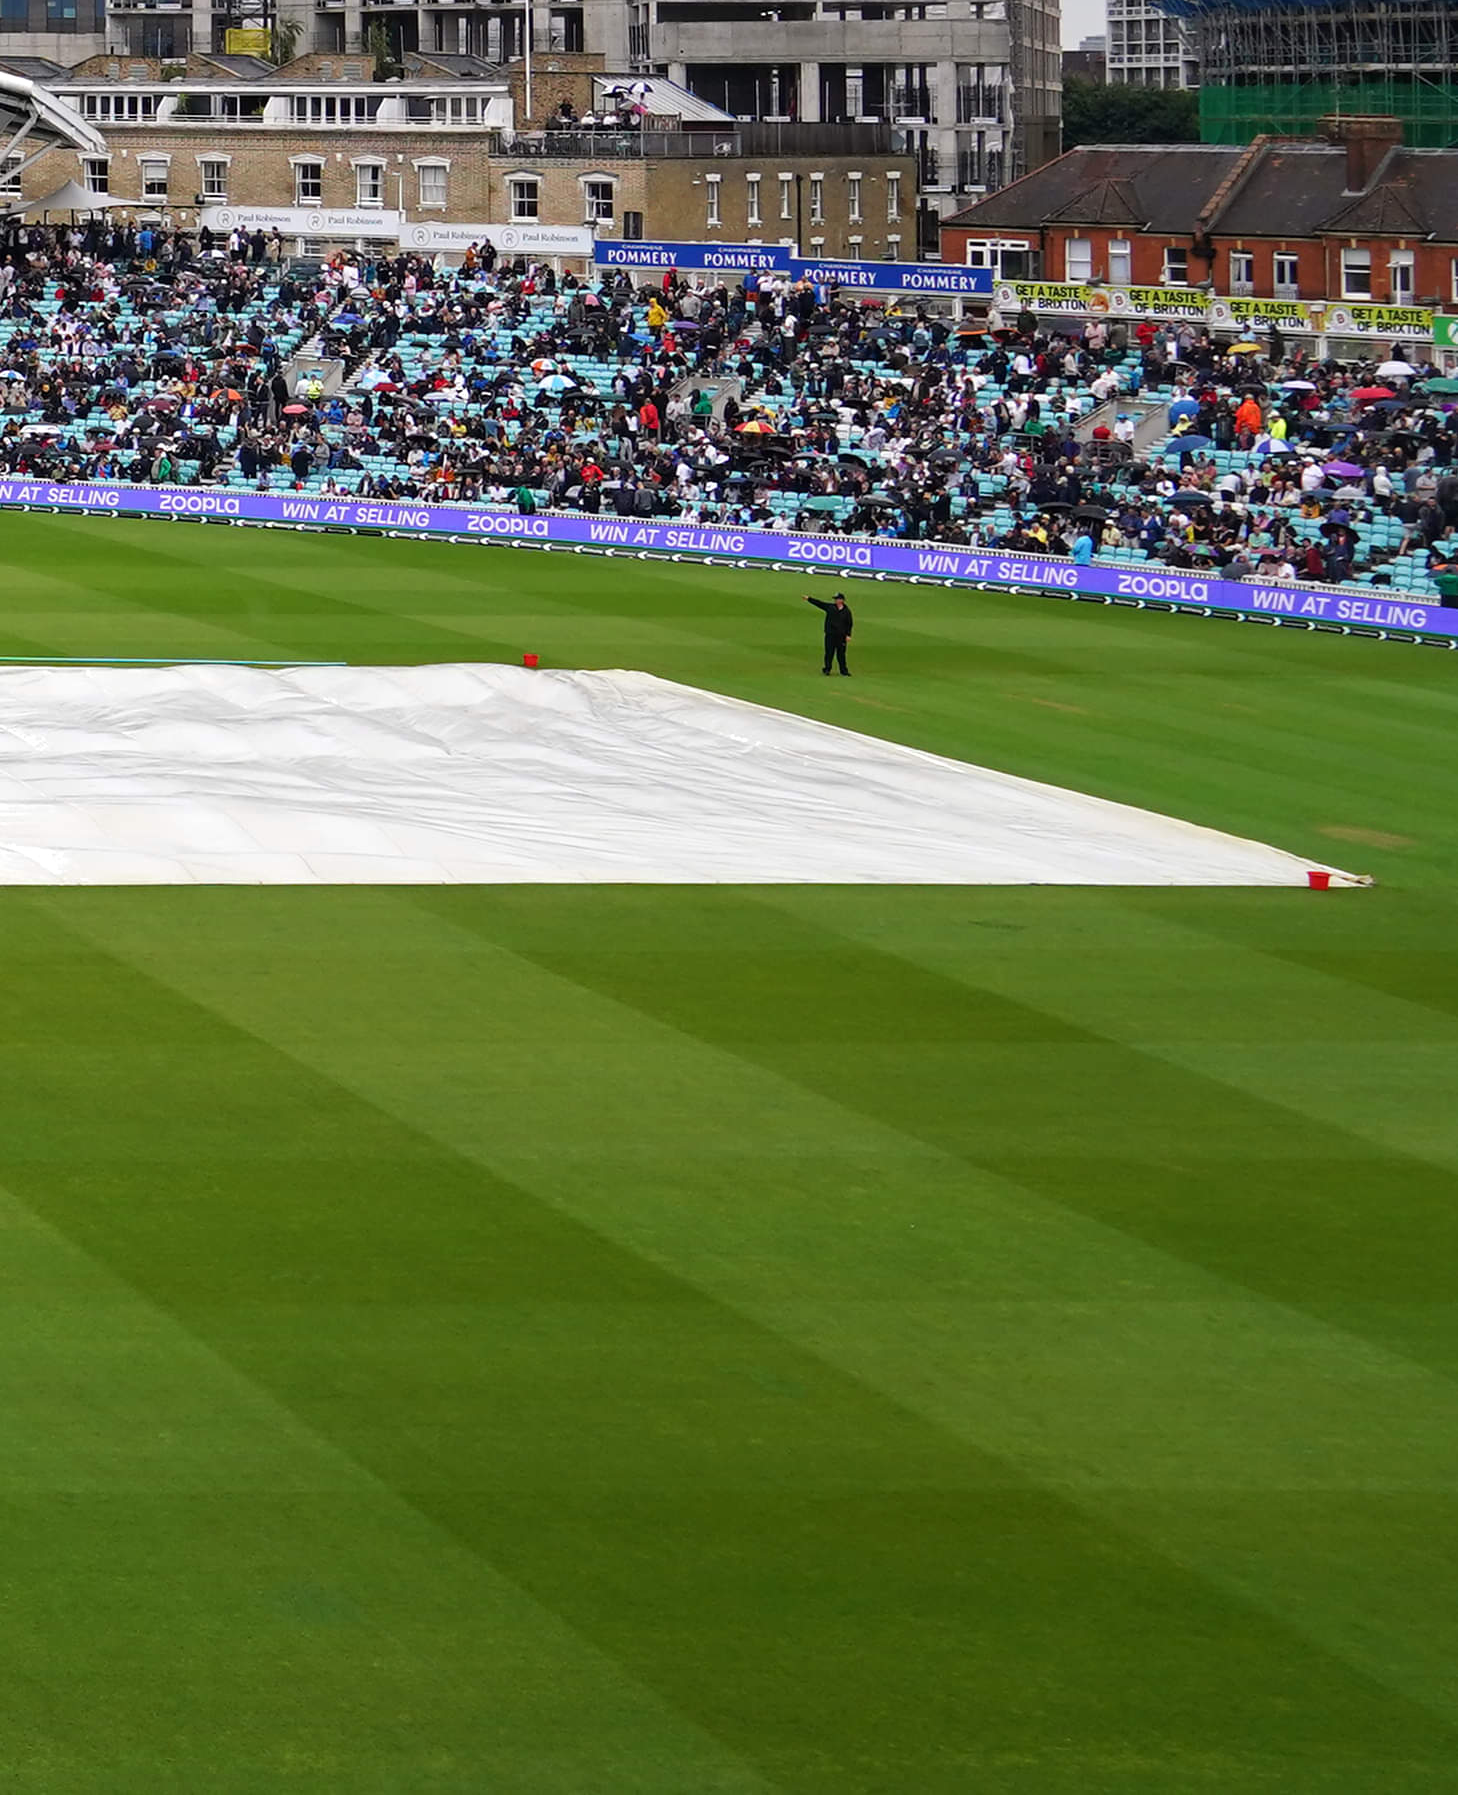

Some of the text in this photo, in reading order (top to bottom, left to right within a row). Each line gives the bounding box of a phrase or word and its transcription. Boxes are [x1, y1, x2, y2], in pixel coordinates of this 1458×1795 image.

[238, 214, 291, 223] Paul Robinson
[328, 216, 383, 226] Paul Robinson
[522, 232, 578, 242] Paul Robinson
[608, 250, 677, 266] POMMERY
[704, 253, 775, 268] POMMERY
[804, 269, 876, 285] POMMERY
[901, 273, 977, 290] POMMERY
[1129, 290, 1197, 304] GET A TASTE
[1135, 305, 1204, 317] OF BRIXTON
[1351, 308, 1423, 322] GET A TASTE
[1357, 321, 1430, 335] OF BRIXTON
[591, 523, 745, 552] WIN AT SELLING
[1254, 590, 1295, 611] WIN
[1300, 596, 1331, 615] AT
[1336, 600, 1427, 628] SELLING
